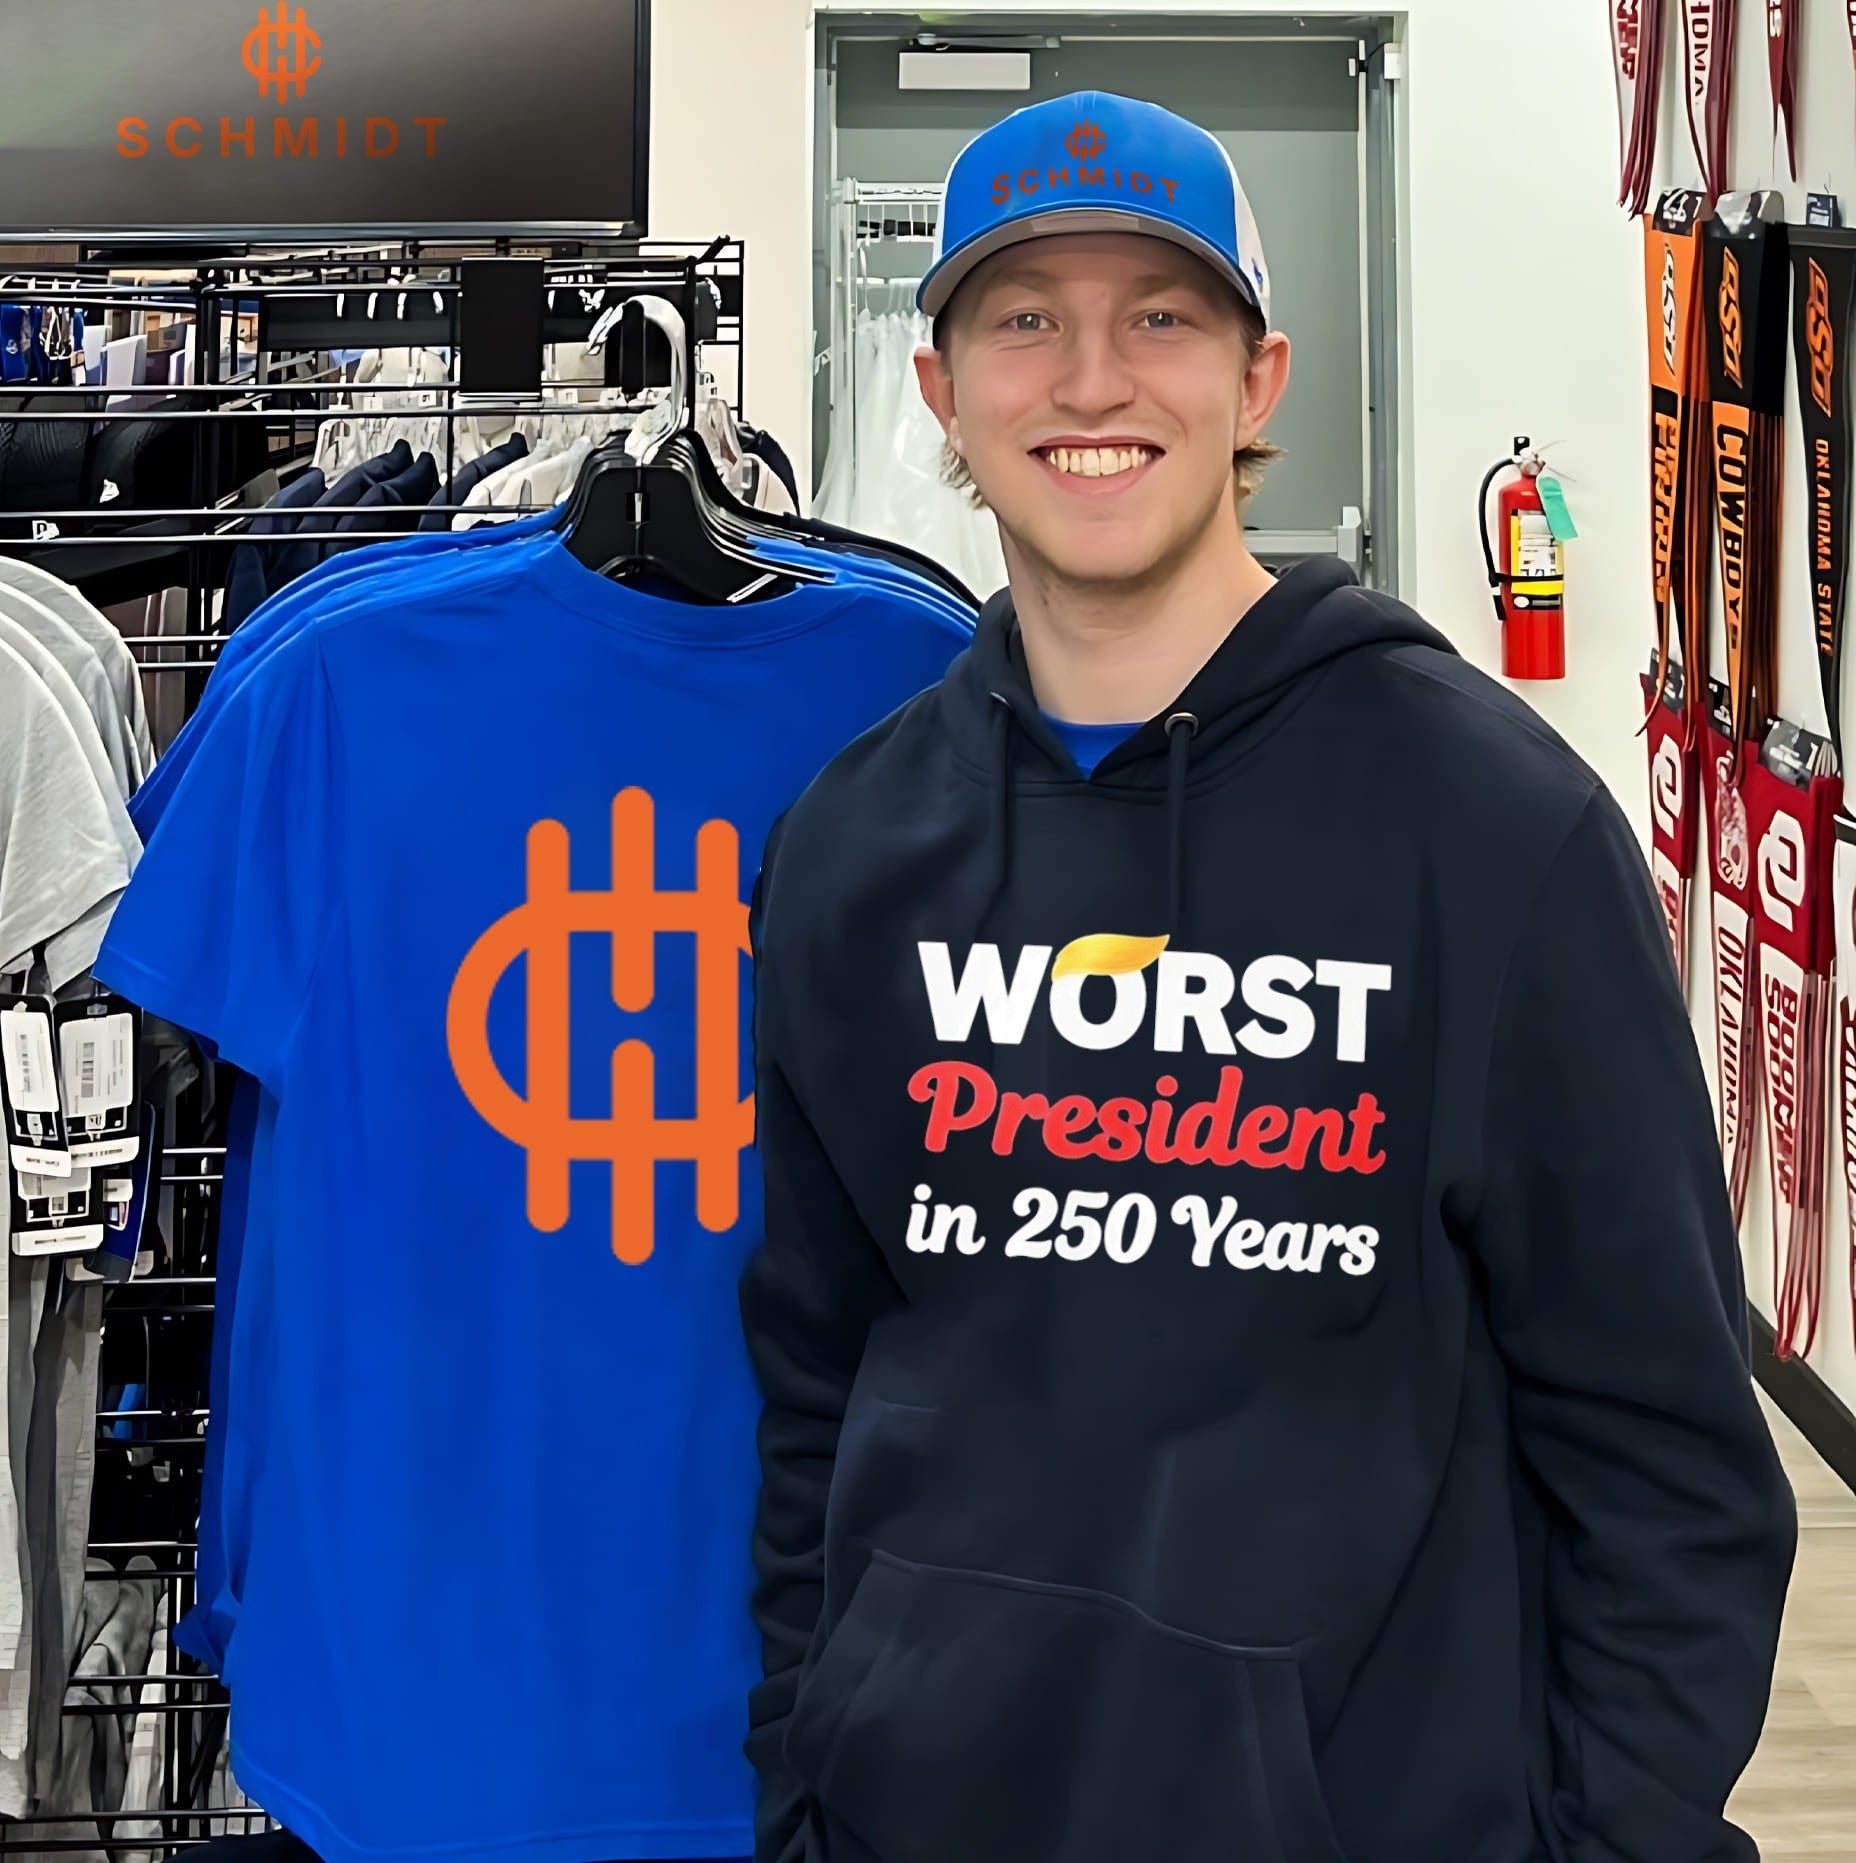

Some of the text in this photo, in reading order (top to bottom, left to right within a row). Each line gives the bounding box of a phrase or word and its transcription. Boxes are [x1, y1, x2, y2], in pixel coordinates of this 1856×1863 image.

[115, 117, 448, 159] SCHMIDT
[991, 166, 1179, 204] SCHMIDT
[1815, 438, 1832, 570] OKLAHOMA
[917, 940, 1392, 1063] WORST
[907, 1060, 1386, 1174] President
[905, 1183, 1380, 1276] in 250 Years
